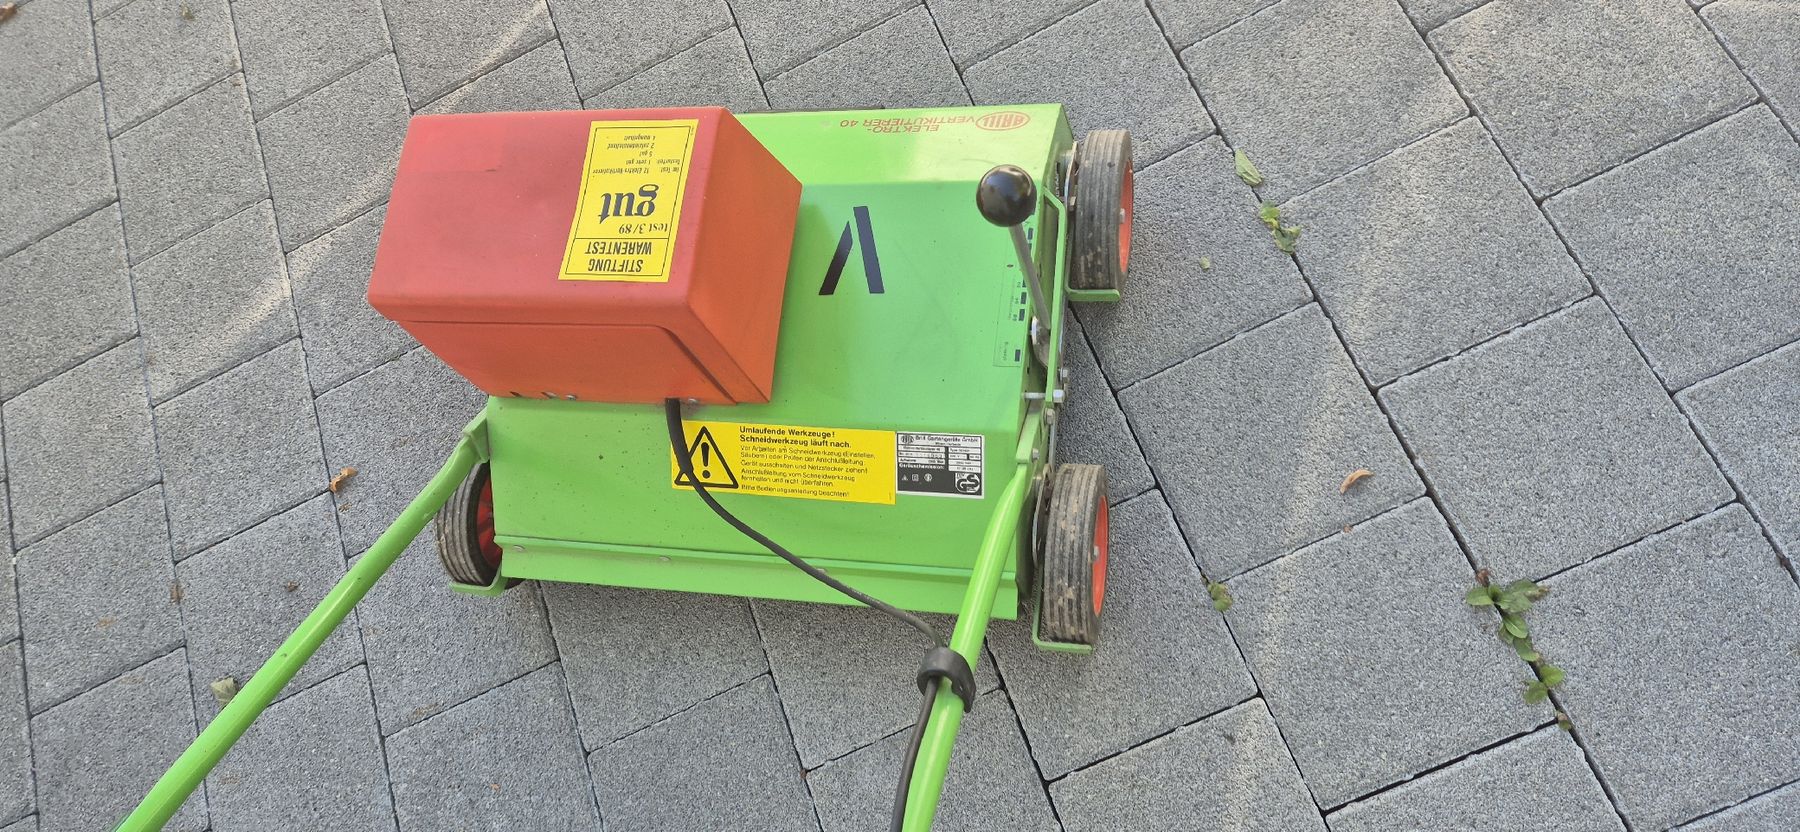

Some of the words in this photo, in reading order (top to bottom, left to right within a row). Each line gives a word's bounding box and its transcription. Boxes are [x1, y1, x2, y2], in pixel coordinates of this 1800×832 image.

[840, 119, 859, 128] 40
[863, 116, 975, 128] VERTIKUTIERER
[598, 184, 659, 225] gut
[649, 223, 669, 233] test
[584, 241, 652, 255] WARENTEST
[588, 259, 644, 273] STIFTUNG
[740, 426, 786, 436] Umlaufende
[788, 429, 835, 439] Werkzeuge!
[740, 434, 809, 447] Schneidwerkzeug
[811, 439, 828, 447] läuft
[830, 441, 852, 449] nach.
[788, 447, 842, 458] Schneidwerkzeug
[802, 471, 856, 483] Schneidwerkzeug
